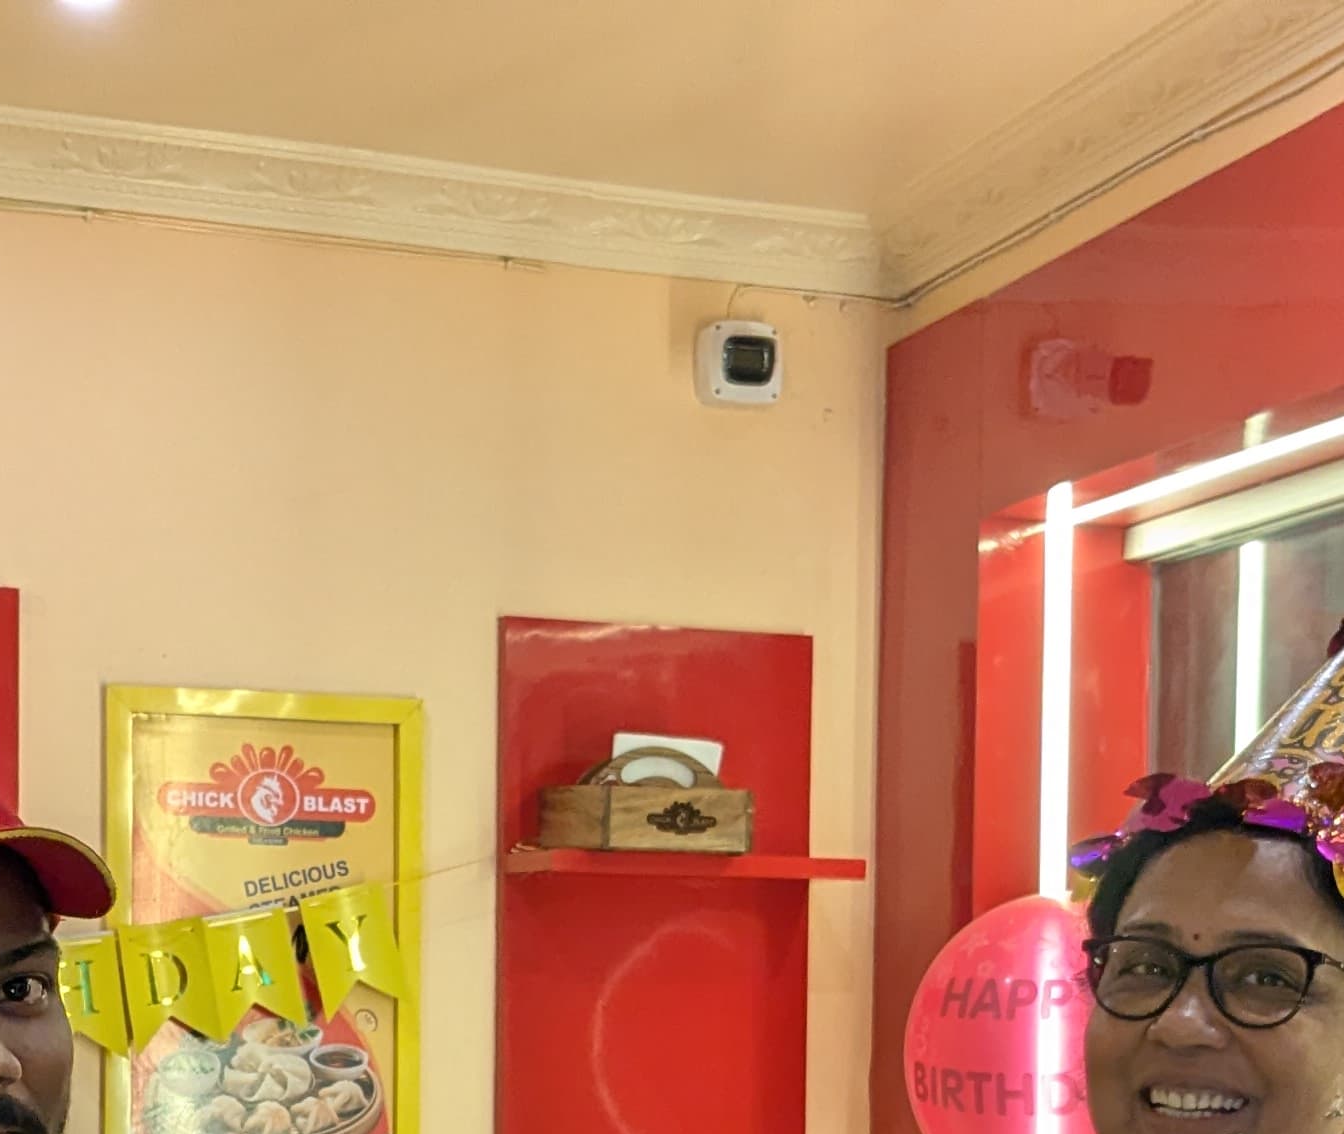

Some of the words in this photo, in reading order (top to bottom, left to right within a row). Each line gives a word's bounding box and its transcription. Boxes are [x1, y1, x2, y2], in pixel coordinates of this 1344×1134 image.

[166, 790, 235, 809] CHICK
[303, 796, 369, 814] BLAST
[244, 860, 350, 898] DELICIOUS
[940, 976, 1075, 1020] HAPP
[913, 1061, 1085, 1117] BIRTHD
